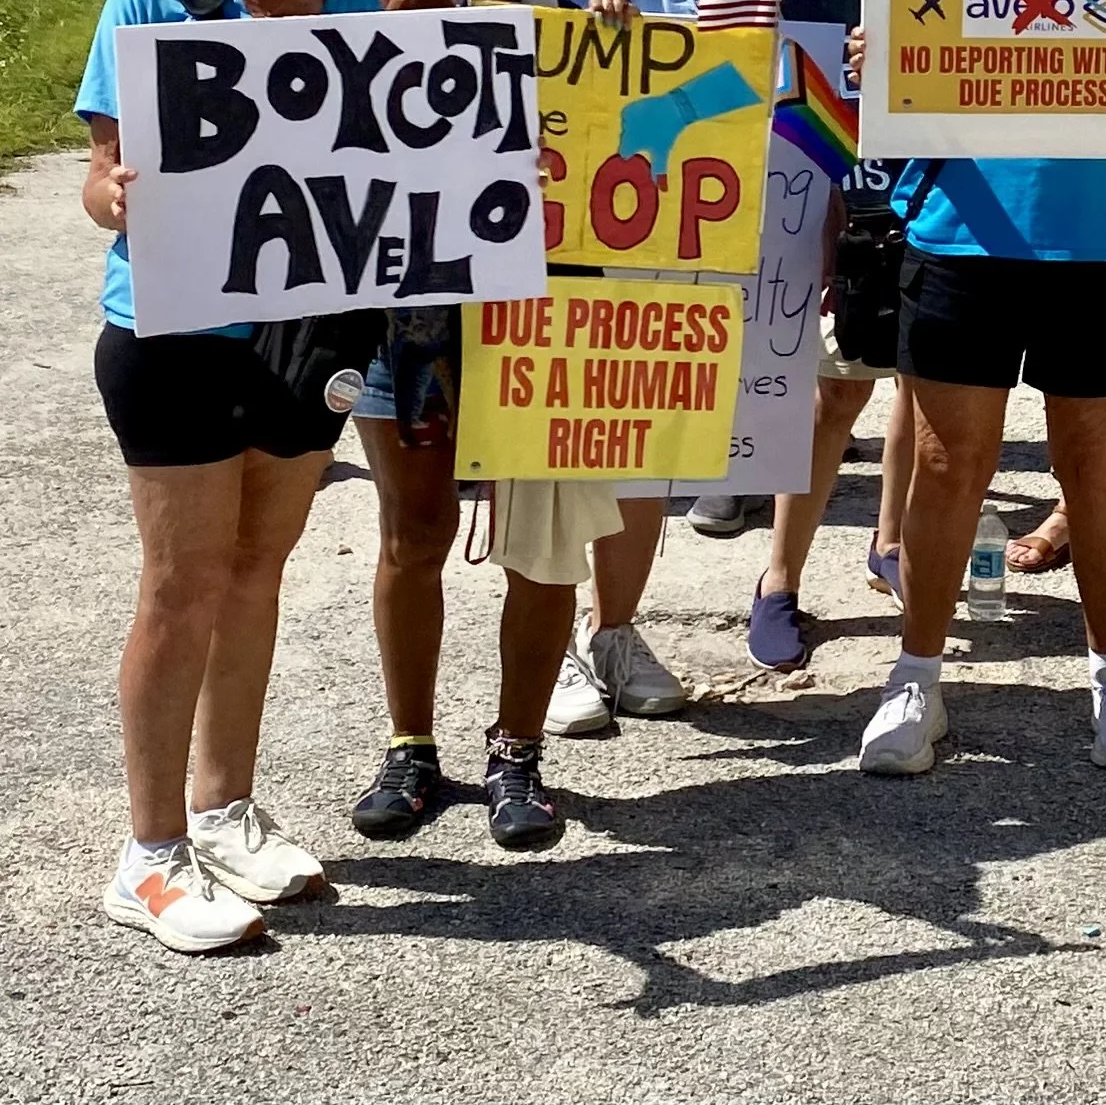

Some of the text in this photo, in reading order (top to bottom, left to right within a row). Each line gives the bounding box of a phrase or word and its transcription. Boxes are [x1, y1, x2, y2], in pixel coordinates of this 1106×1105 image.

[535, 17, 695, 96] UMP
[900, 45, 932, 74] NO
[940, 45, 1064, 76] DEPORTING
[155, 20, 535, 174] BOYCOTT
[959, 78, 1003, 107] DUE
[222, 164, 530, 299] AVELO
[481, 297, 731, 354] DUE PROCESS
[499, 356, 535, 408] IS
[545, 357, 569, 408] A
[582, 359, 719, 412] HUMAN
[547, 417, 652, 469] RIGHT
